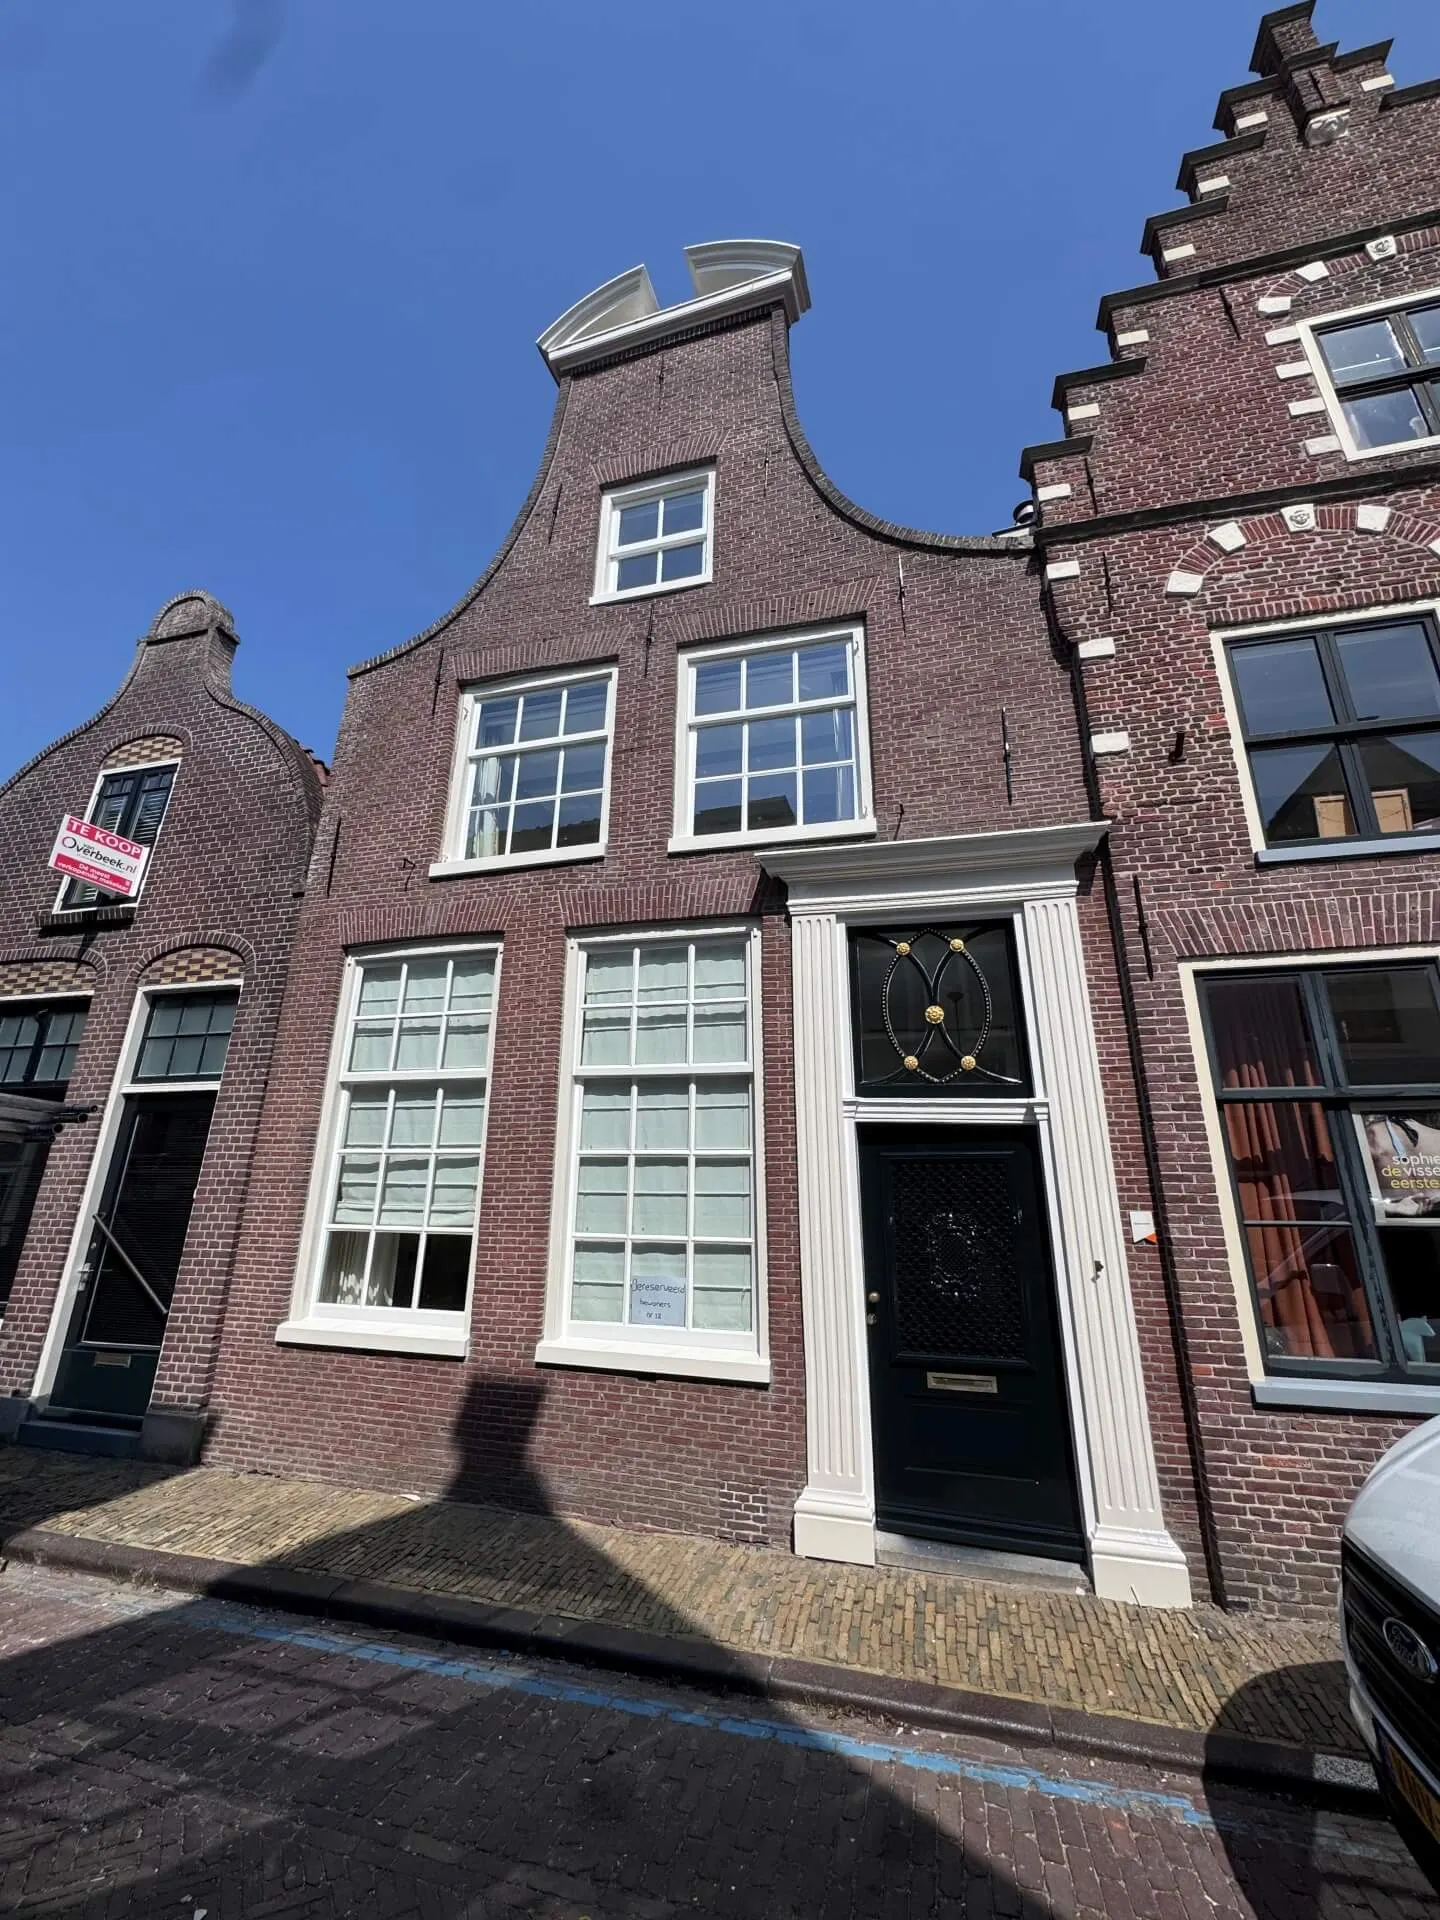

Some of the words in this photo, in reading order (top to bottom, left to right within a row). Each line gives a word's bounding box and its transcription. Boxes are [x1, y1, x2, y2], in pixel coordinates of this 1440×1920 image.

[70, 819, 90, 836] TE
[94, 829, 141, 856] KOOP
[62, 836, 137, 874] Overbeek.nl
[1392, 1152, 1440, 1167] sophie
[1381, 1165, 1401, 1177] de
[1390, 1178, 1440, 1189] eerste
